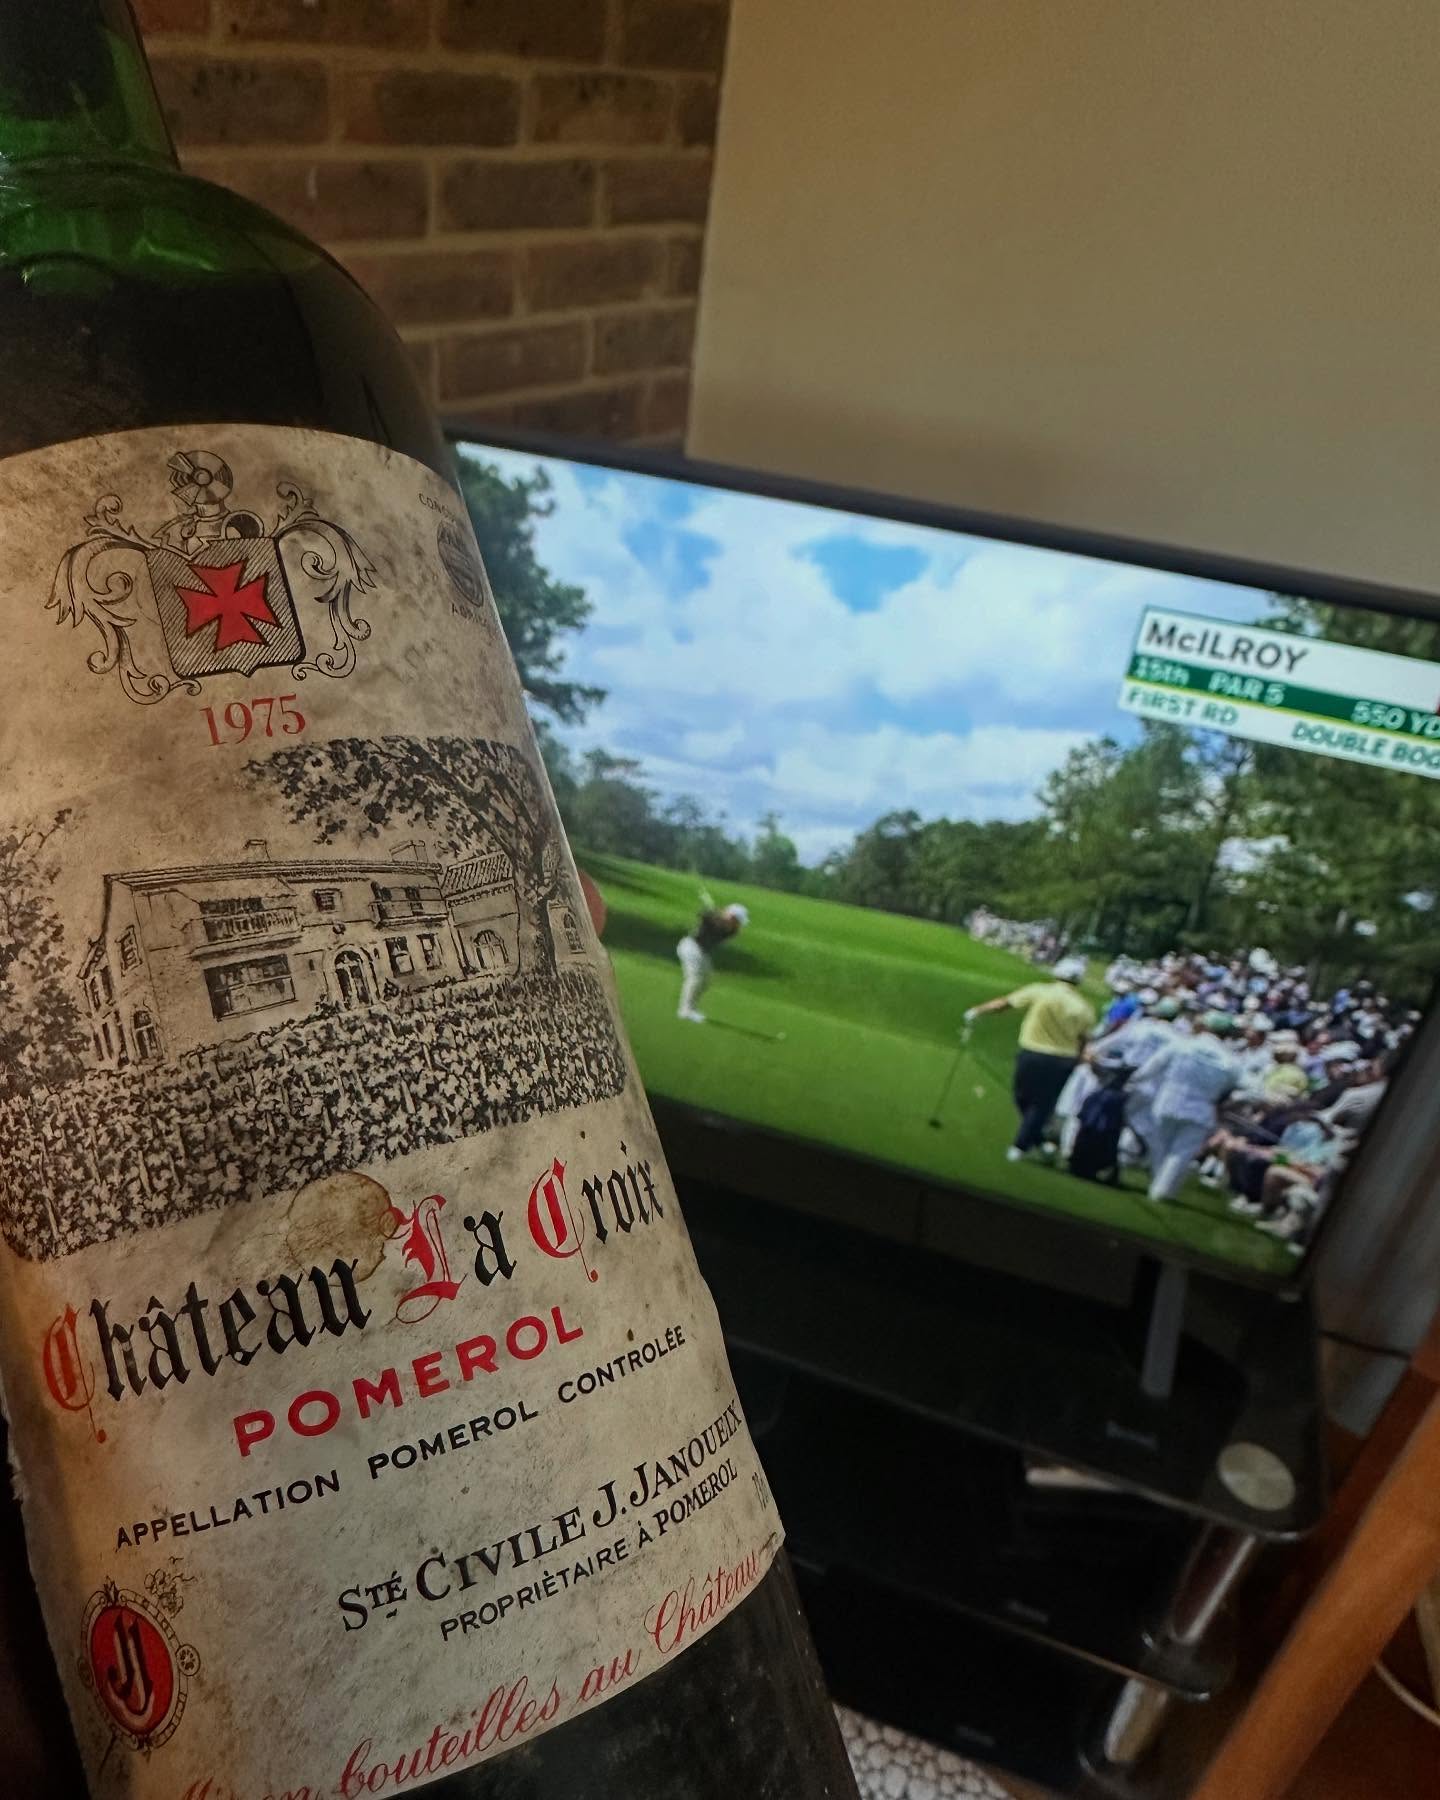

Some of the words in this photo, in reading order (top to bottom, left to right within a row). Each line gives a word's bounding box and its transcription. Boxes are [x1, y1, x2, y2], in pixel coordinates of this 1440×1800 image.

[1145, 621, 1308, 673] McILROY
[1208, 671, 1264, 702] PAR
[1264, 683, 1287, 707] 5
[200, 693, 306, 747] 1975
[1128, 687, 1196, 716] FIRST
[1201, 703, 1238, 726] RD
[1292, 720, 1389, 759] DOUBLE
[42, 1255, 372, 1443] Château
[381, 1195, 517, 1324] La
[526, 1141, 665, 1283] Croix
[233, 1305, 585, 1457] POMEROL
[115, 1469, 340, 1551] APPELLATION
[367, 1402, 539, 1481] POMEROL
[557, 1324, 686, 1403] CONTROLÉE
[653, 1458, 738, 1536] POMEROL
[416, 1506, 587, 1601] CIVILE
[334, 1674, 560, 1799] bouteilles
[576, 1649, 641, 1704] au
[644, 1551, 764, 1653] Château
